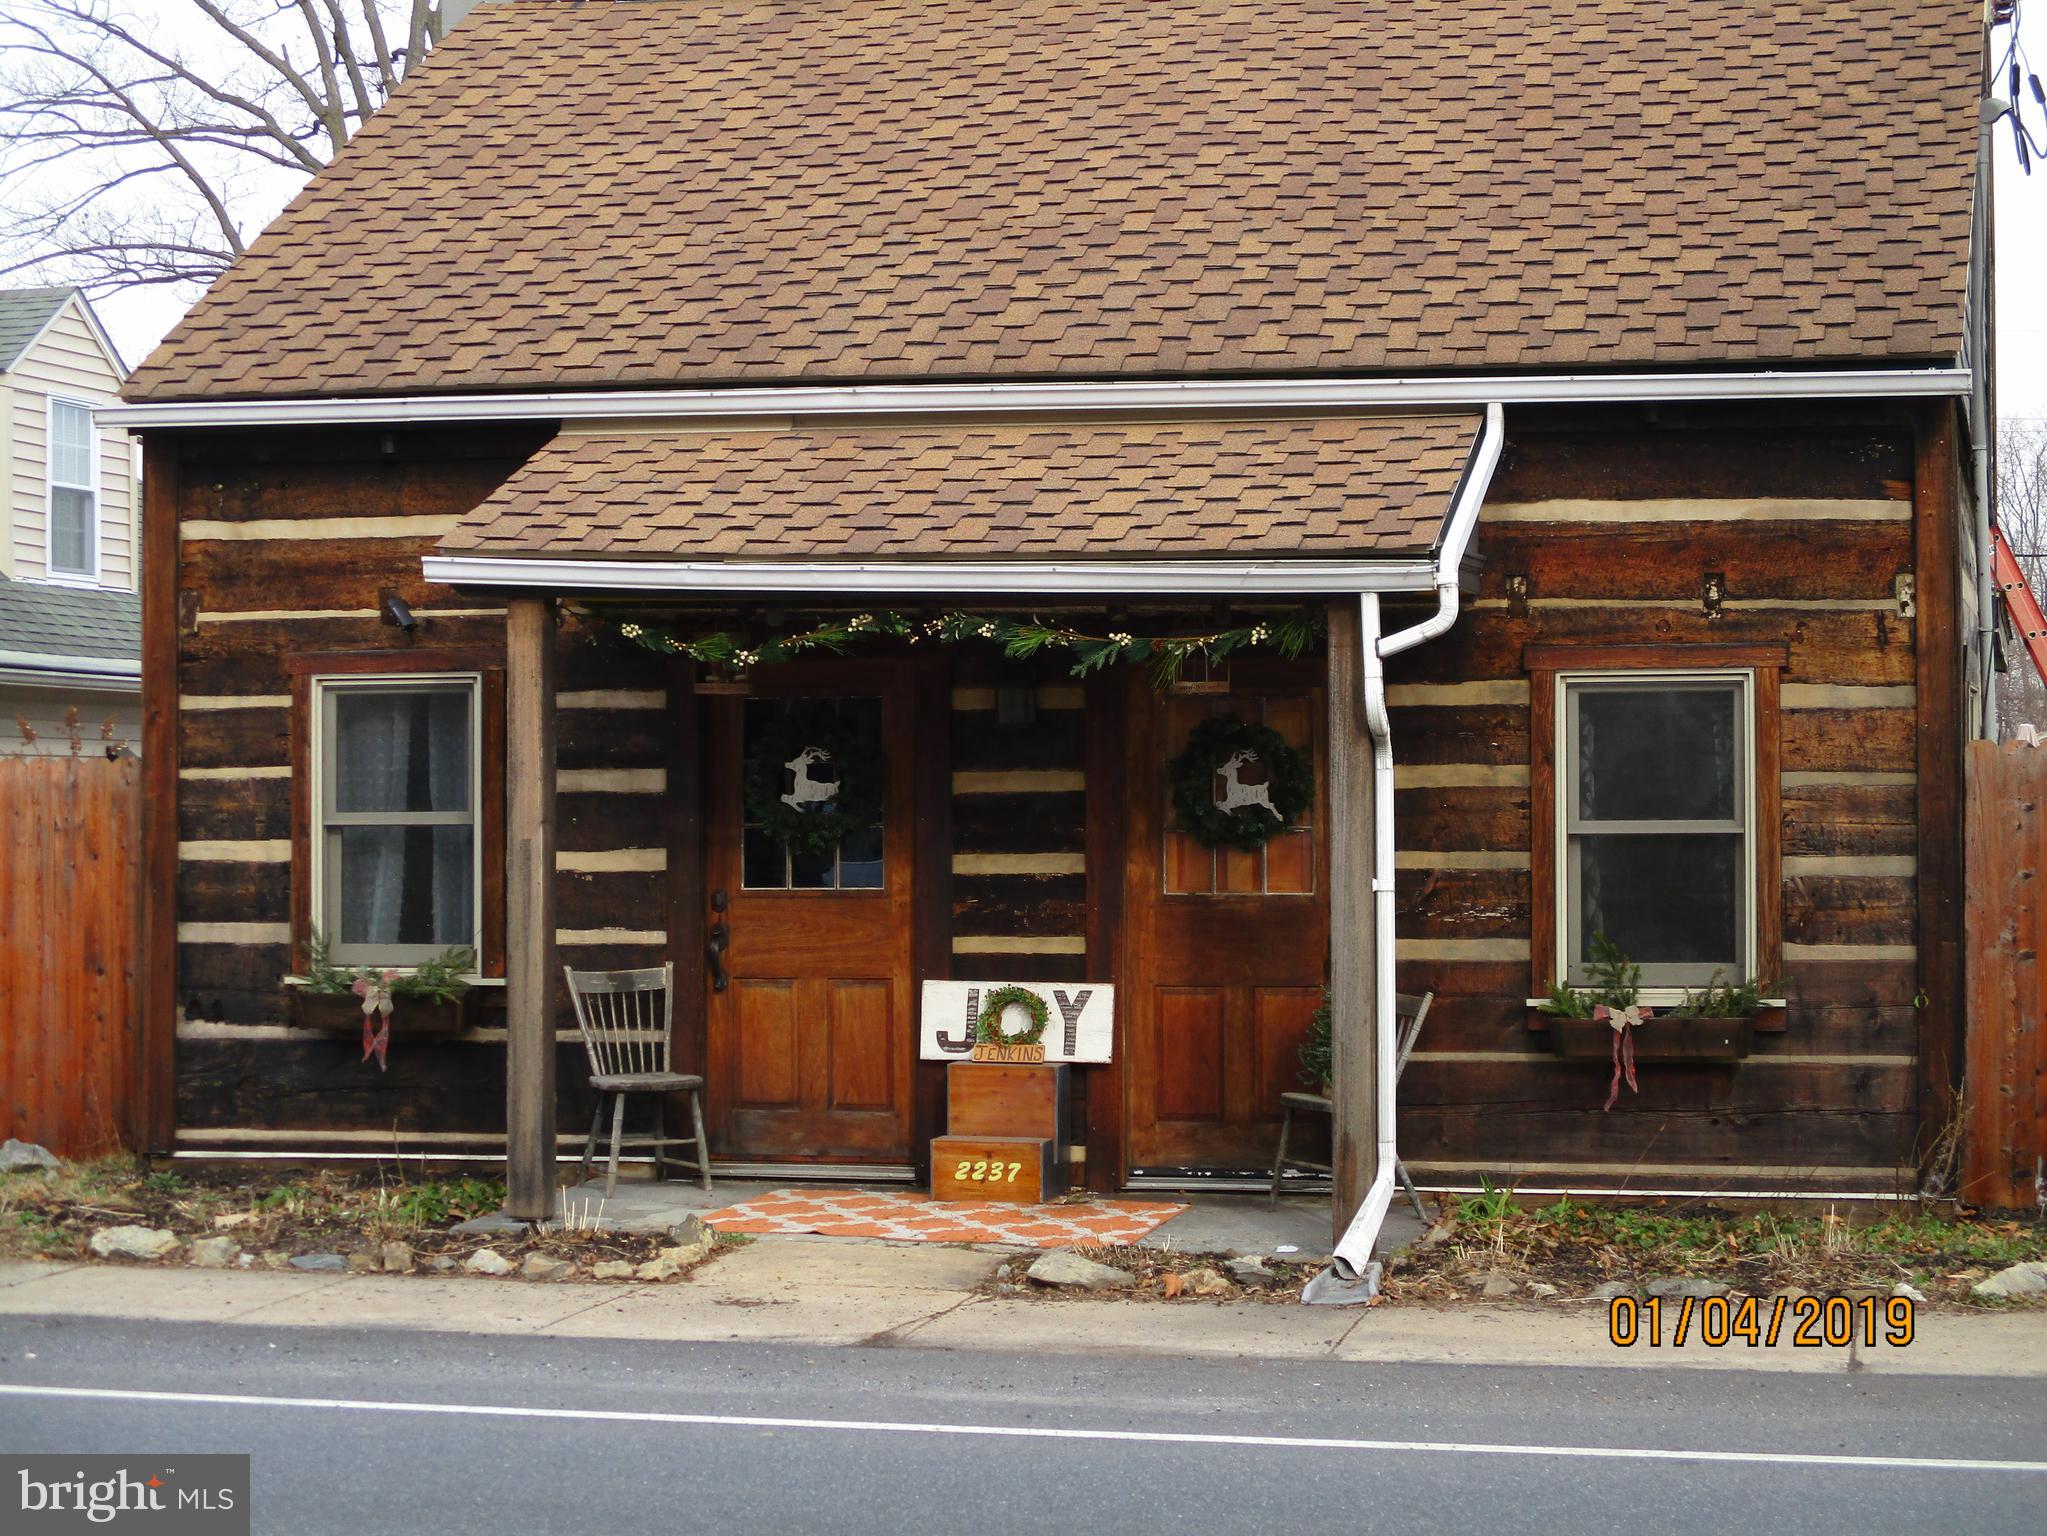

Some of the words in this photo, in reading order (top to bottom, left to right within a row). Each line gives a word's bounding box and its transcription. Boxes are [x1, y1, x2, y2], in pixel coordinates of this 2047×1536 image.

[936, 986, 1093, 1056] JOY
[973, 1044, 1043, 1061] JENKINS
[954, 1161, 1022, 1183] 2237
